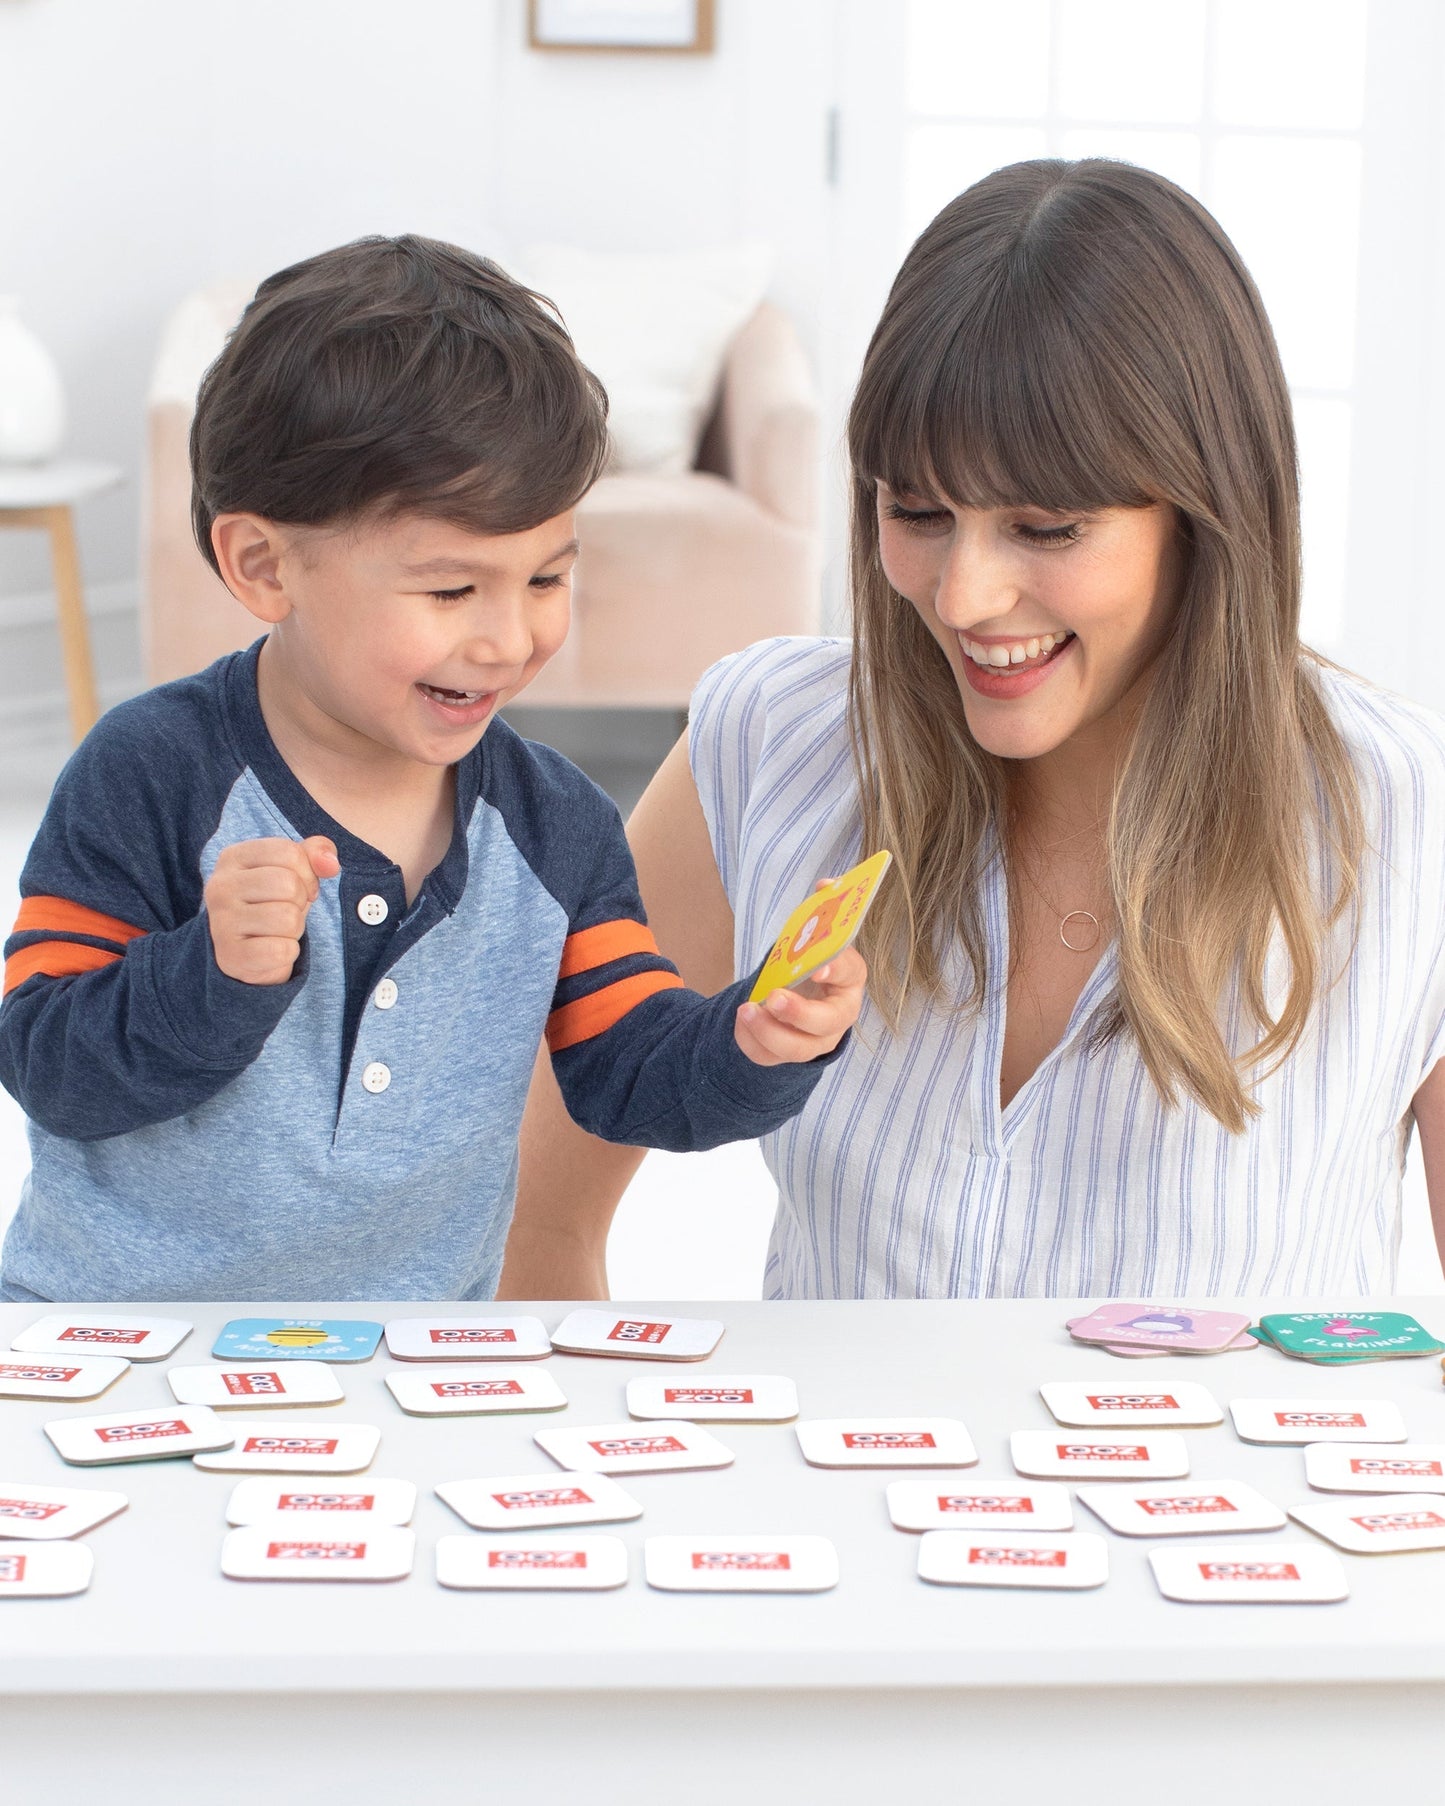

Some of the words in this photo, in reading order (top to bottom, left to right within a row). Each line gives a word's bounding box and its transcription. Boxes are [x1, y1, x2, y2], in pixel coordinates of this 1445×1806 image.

[1290, 1313, 1384, 1323] FRANNY
[72, 1329, 141, 1338] ZOO
[615, 1323, 648, 1339] ZOO
[1303, 1336, 1414, 1348] FLAMINGO
[246, 1374, 278, 1392] ZOO
[441, 1382, 510, 1391] ZOO
[674, 1394, 744, 1402] ZOO
[1097, 1396, 1166, 1405] ZOO
[1283, 1413, 1354, 1422] ZOO
[105, 1422, 179, 1437] ZOO
[852, 1434, 923, 1443] ZOO
[255, 1439, 329, 1449] ZOO
[600, 1438, 672, 1450] ZOO
[1065, 1446, 1138, 1456] ZOO
[1359, 1460, 1432, 1470] ZOO
[288, 1495, 364, 1505] ZOO
[503, 1490, 578, 1504] ZOO
[947, 1497, 1021, 1508] ZOO
[1146, 1498, 1221, 1511] ZOO
[0, 1505, 46, 1519] OO
[279, 1548, 357, 1559] ZOO
[978, 1549, 1055, 1561] ZOO
